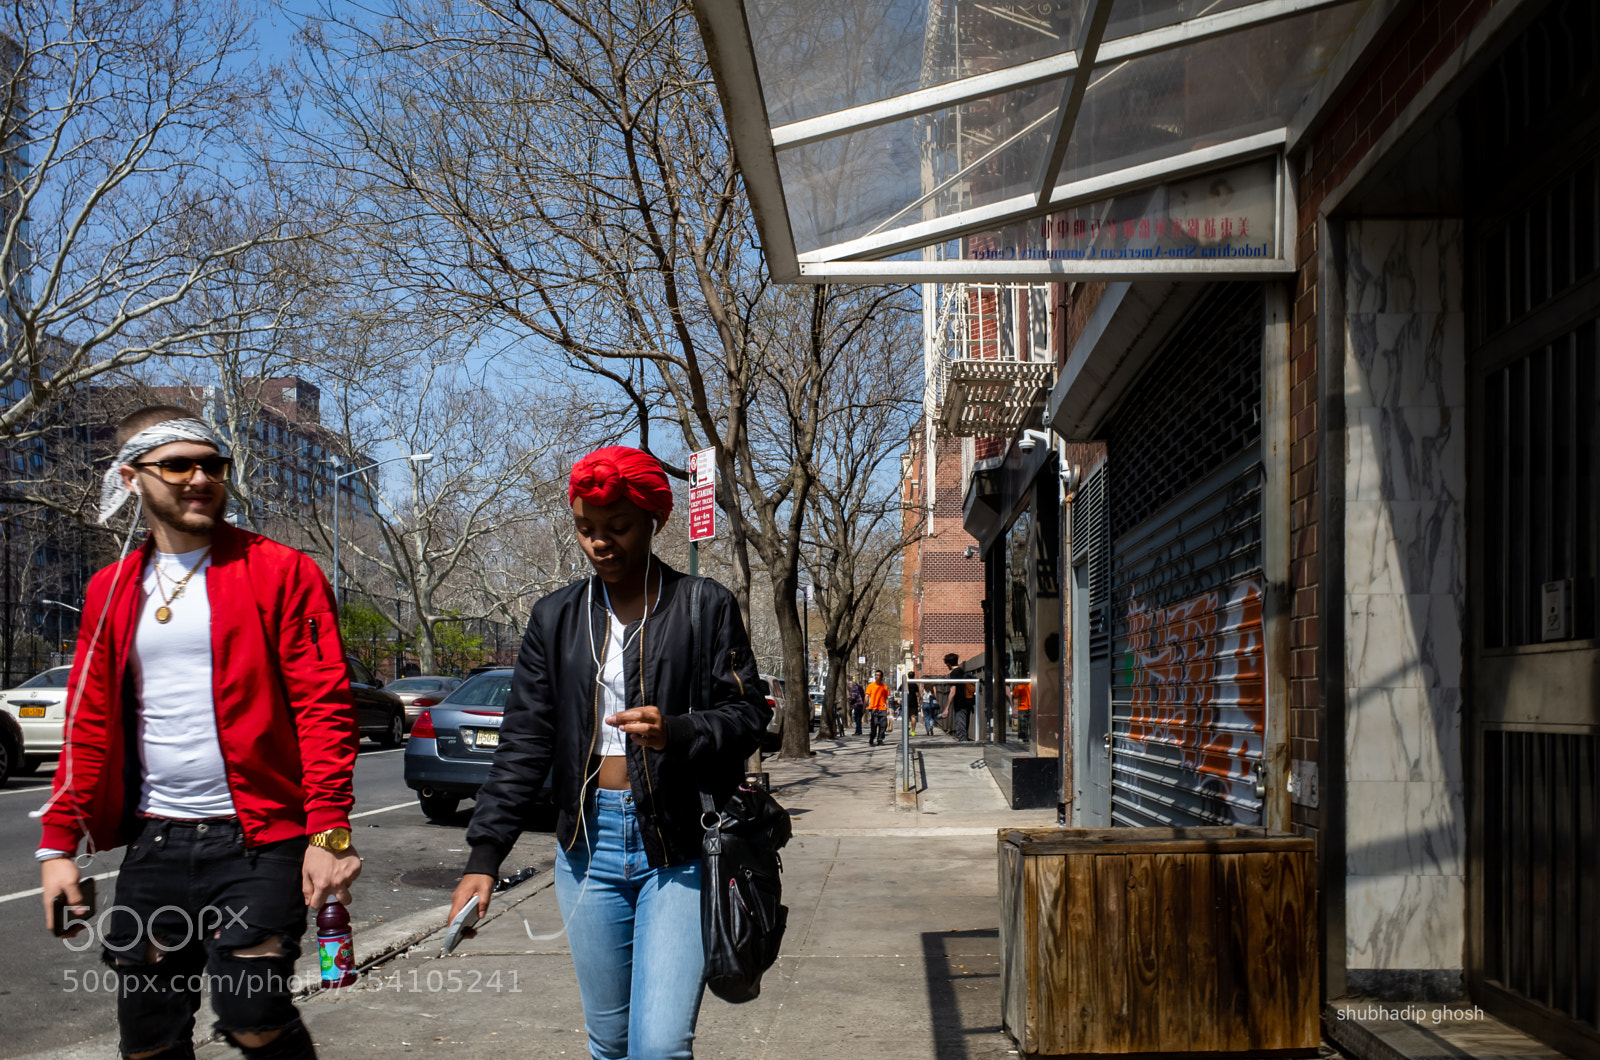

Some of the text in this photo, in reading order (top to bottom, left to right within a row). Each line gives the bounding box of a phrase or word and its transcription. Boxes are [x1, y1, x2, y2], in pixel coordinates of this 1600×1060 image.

[691, 487, 713, 500] NO STANDING
[691, 497, 712, 508] EXCEPT TRUCKS
